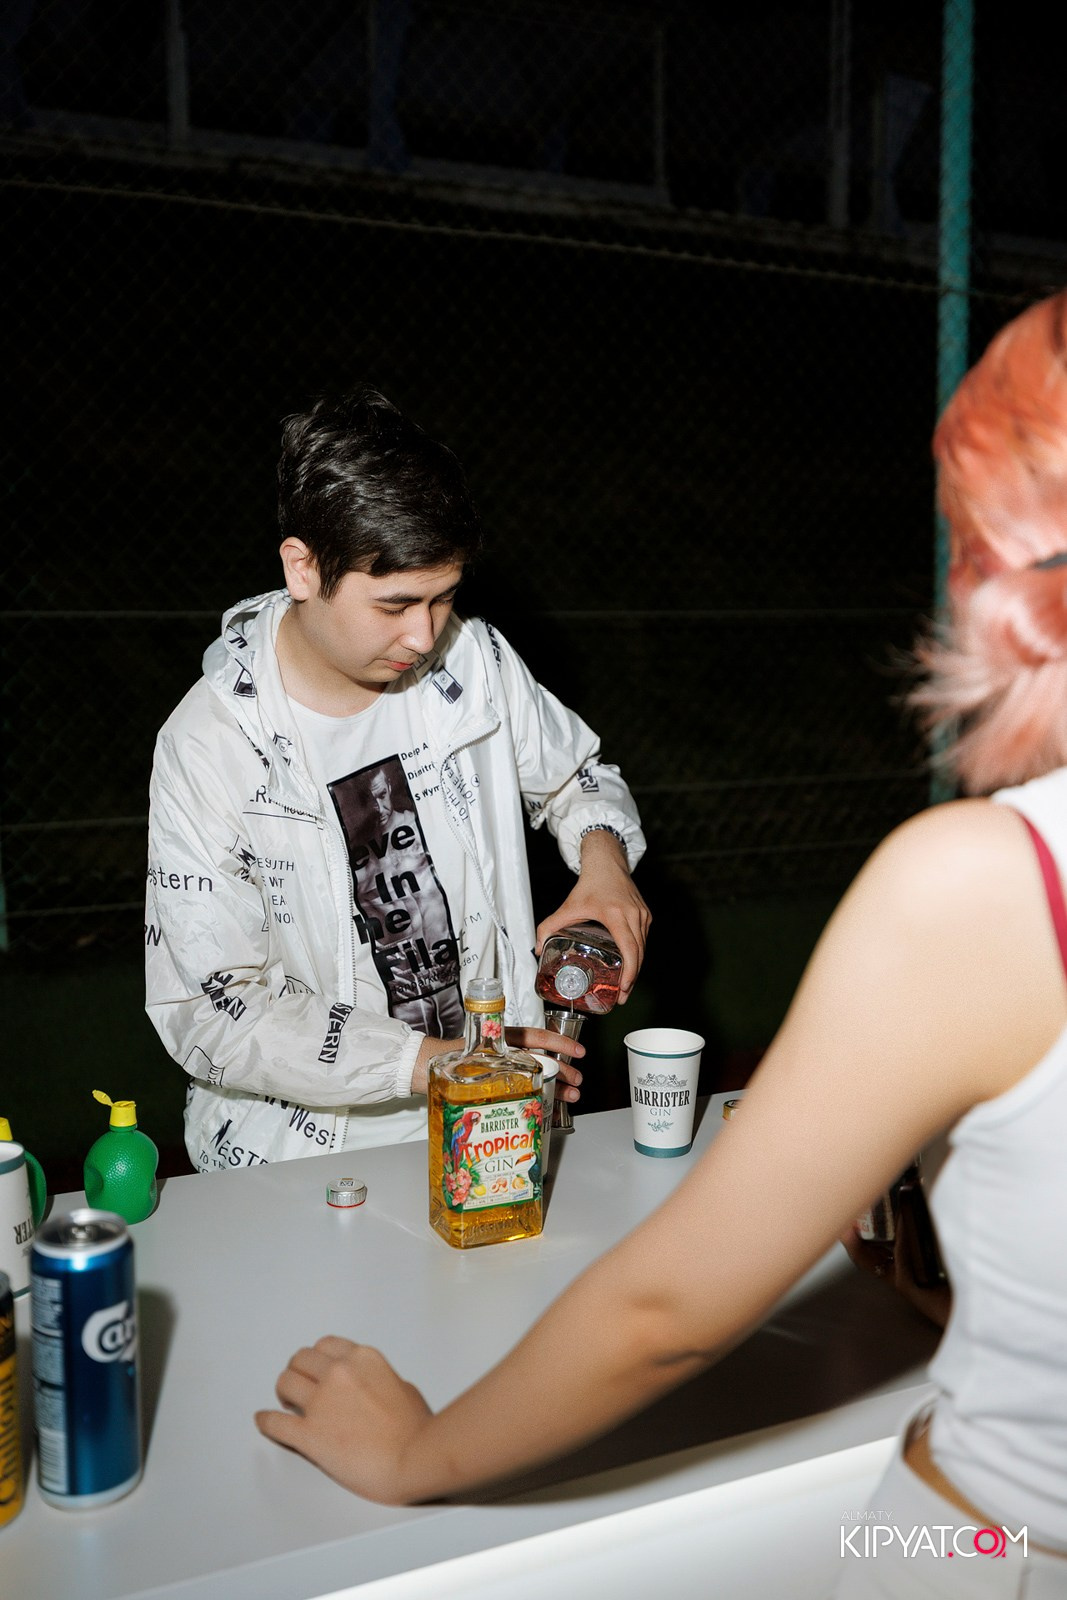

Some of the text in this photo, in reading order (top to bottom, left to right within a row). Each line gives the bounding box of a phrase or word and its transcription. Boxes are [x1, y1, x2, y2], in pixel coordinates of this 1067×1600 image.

[375, 870, 421, 904] In
[633, 1086, 690, 1108] BARRISTER
[649, 1108, 672, 1117] GIN
[480, 1118, 520, 1133] BARRISTER
[460, 1129, 535, 1168] Tropical
[484, 1158, 514, 1173] GIN
